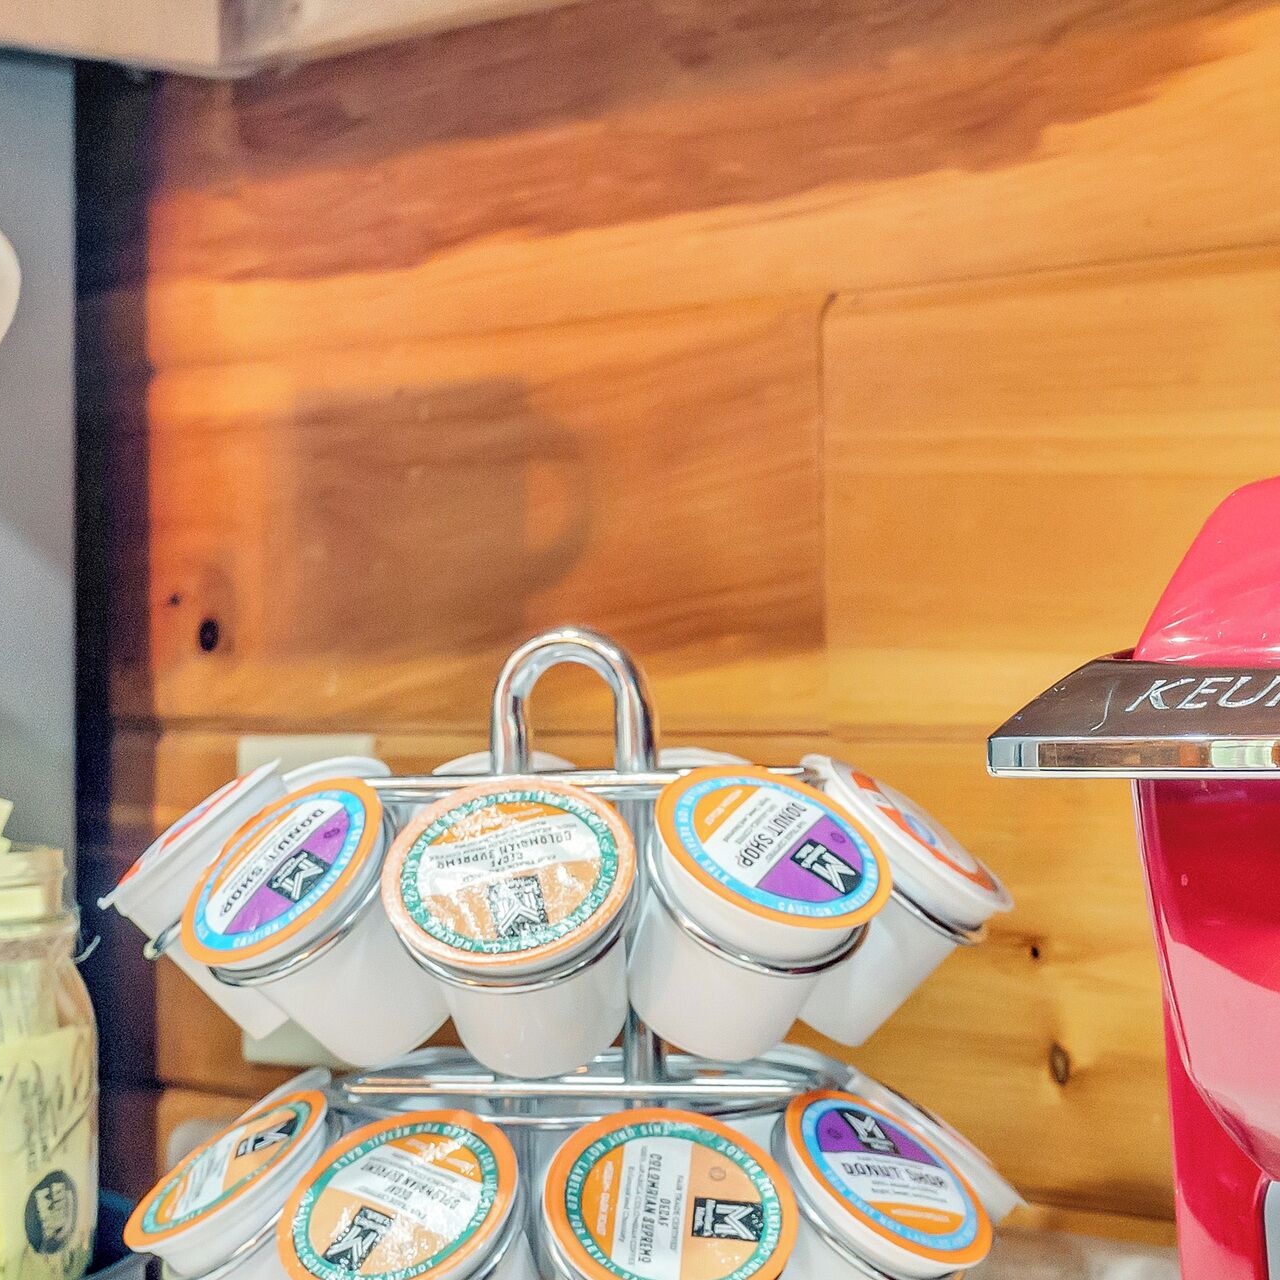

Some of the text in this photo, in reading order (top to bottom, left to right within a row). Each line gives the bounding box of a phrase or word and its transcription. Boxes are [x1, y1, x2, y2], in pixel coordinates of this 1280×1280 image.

[764, 800, 808, 836] DONUT
[734, 831, 775, 868] SHOP
[839, 1161, 904, 1179] DONUT
[566, 1159, 589, 1209] LABELED
[579, 1237, 619, 1272] RETAIL
[637, 1152, 662, 1264] COLOMBIAN SUPREMO
